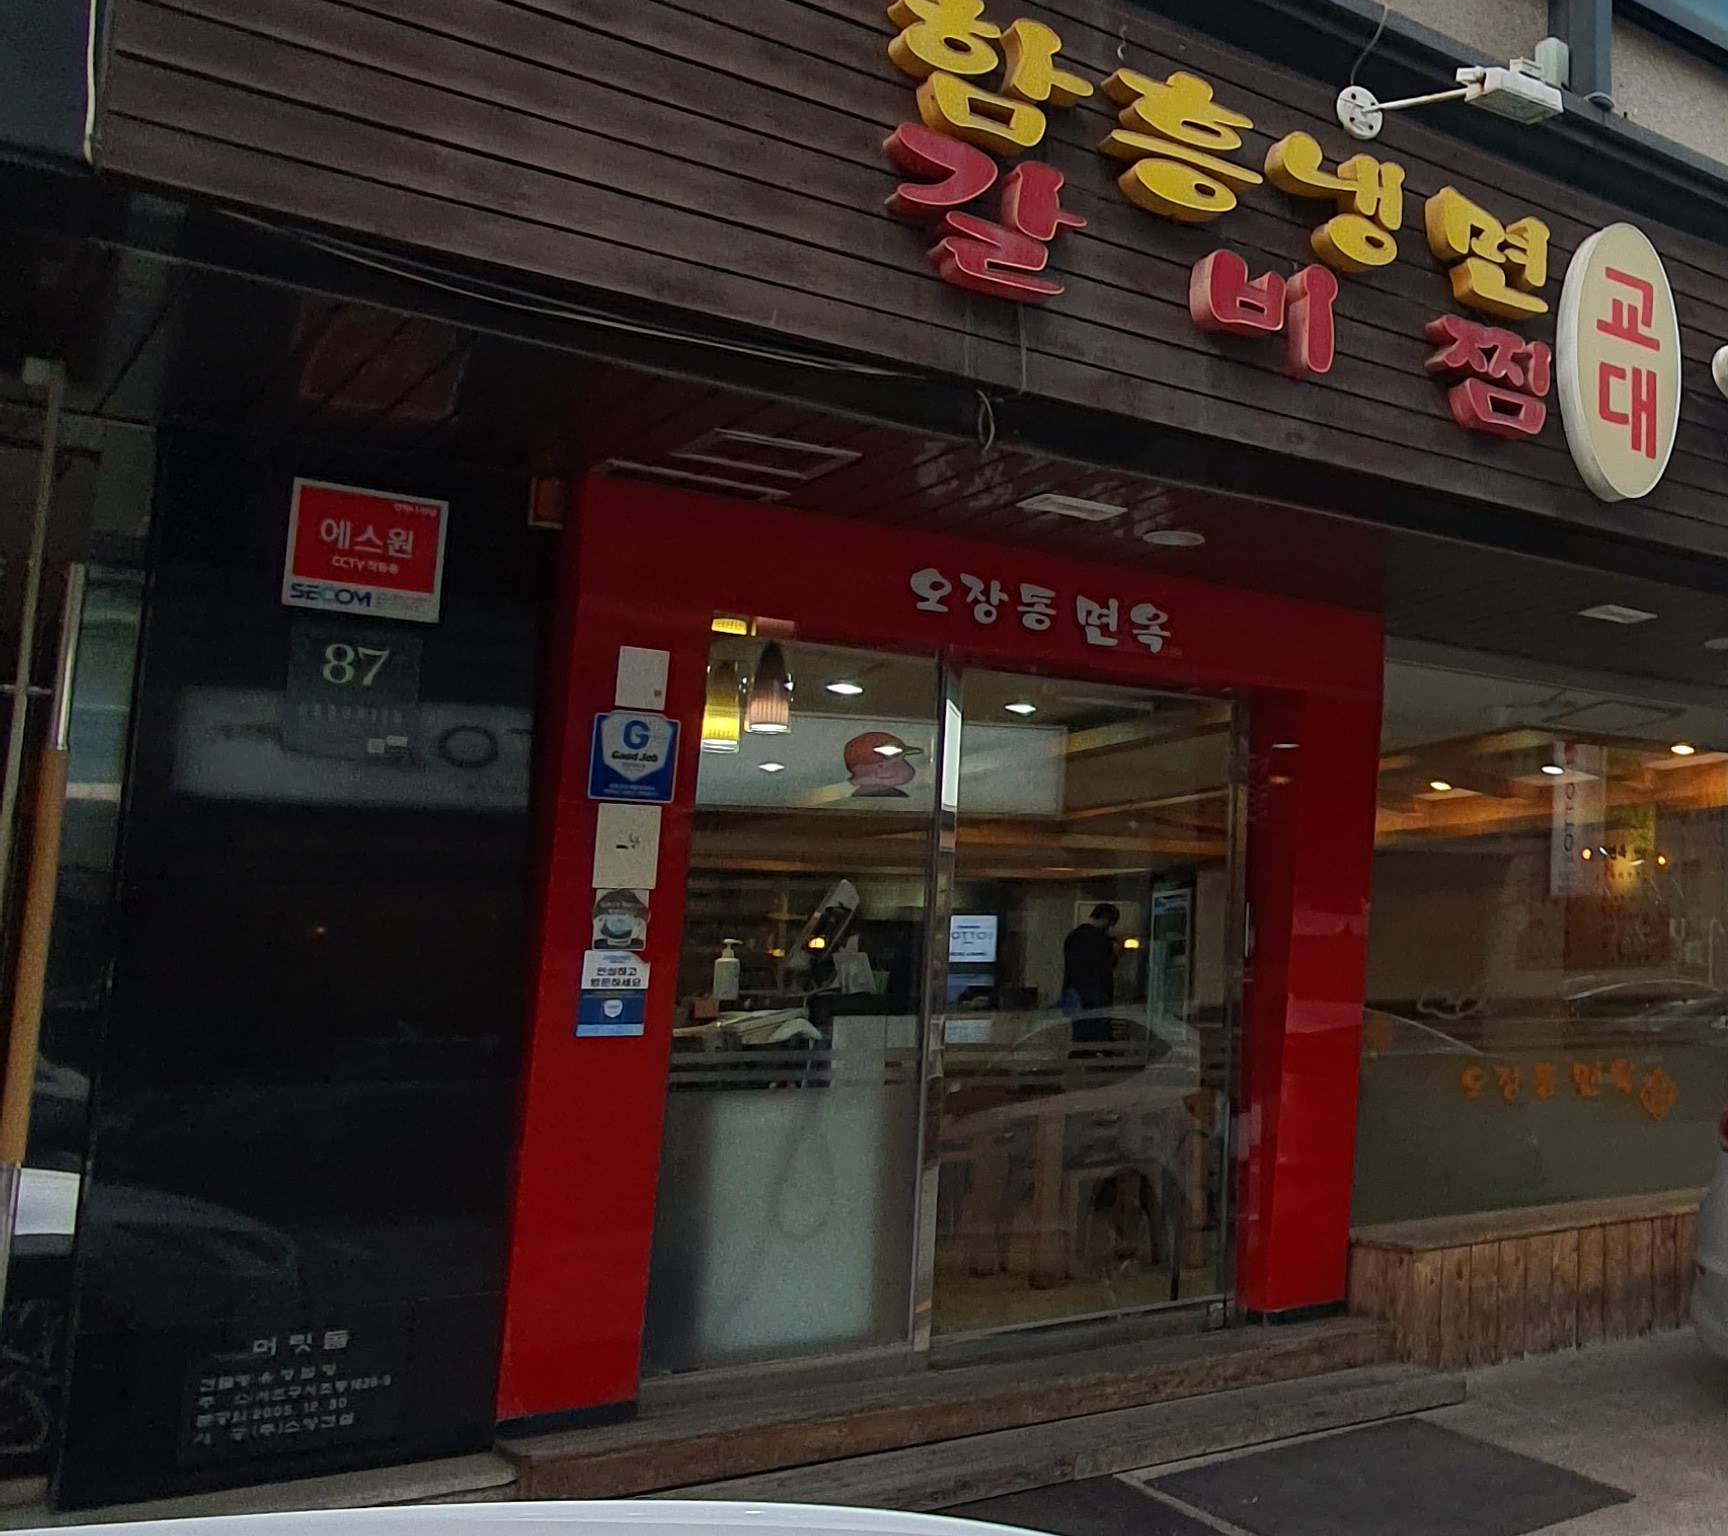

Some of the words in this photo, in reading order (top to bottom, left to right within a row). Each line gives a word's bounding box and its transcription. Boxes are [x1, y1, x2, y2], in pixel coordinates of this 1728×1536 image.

[882, 122, 1552, 440] 갈비찜
[1597, 267, 1661, 461] 교대
[319, 518, 414, 560] 에스원
[290, 582, 372, 607] SECOM
[323, 643, 390, 686] 87
[612, 750, 638, 761] Good
[639, 752, 659, 762] Job
[623, 720, 650, 750] G
